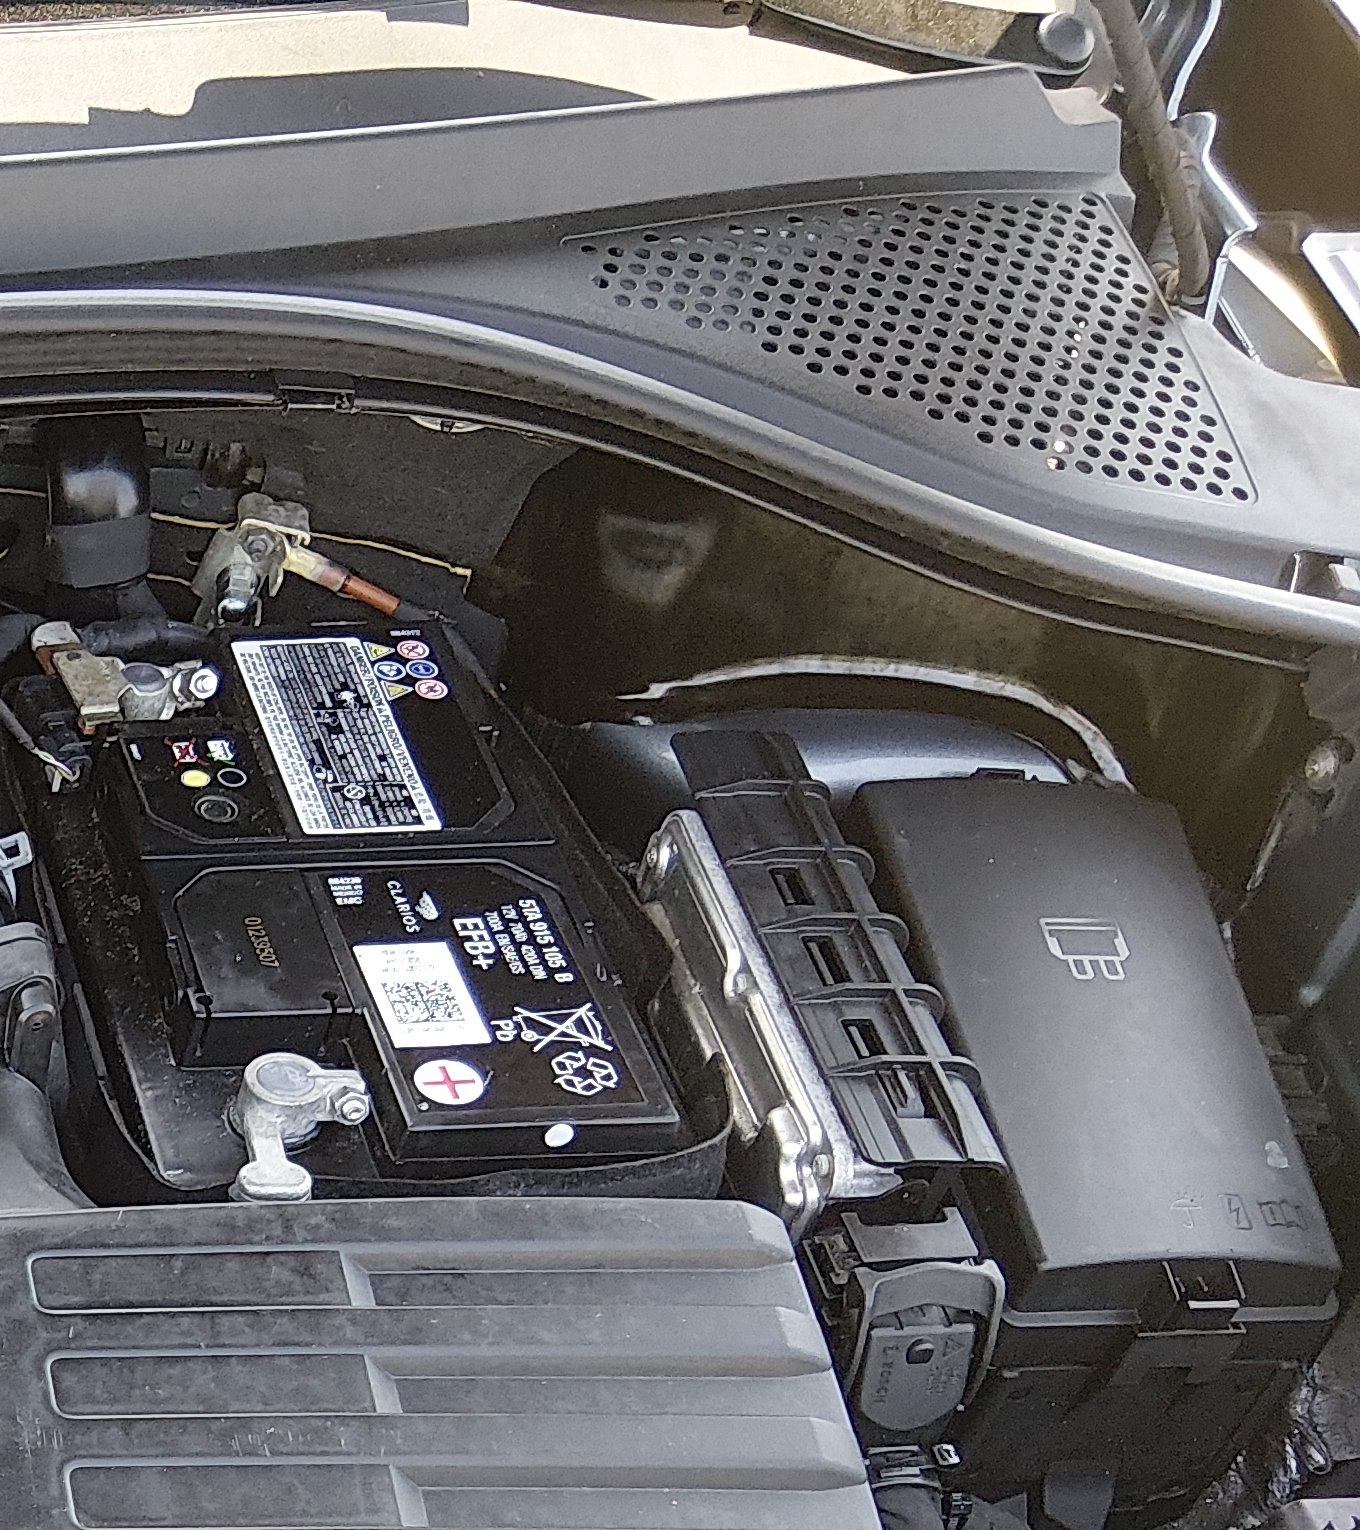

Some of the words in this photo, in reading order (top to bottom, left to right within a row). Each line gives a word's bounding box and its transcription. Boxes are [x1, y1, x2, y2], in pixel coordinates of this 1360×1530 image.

[387, 880, 421, 933] CLARIOS
[519, 899, 543, 921] 5TA
[453, 917, 495, 970] EFB+
[529, 921, 555, 945] 915
[542, 945, 568, 968] 105
[490, 1019, 516, 1042] Pb
